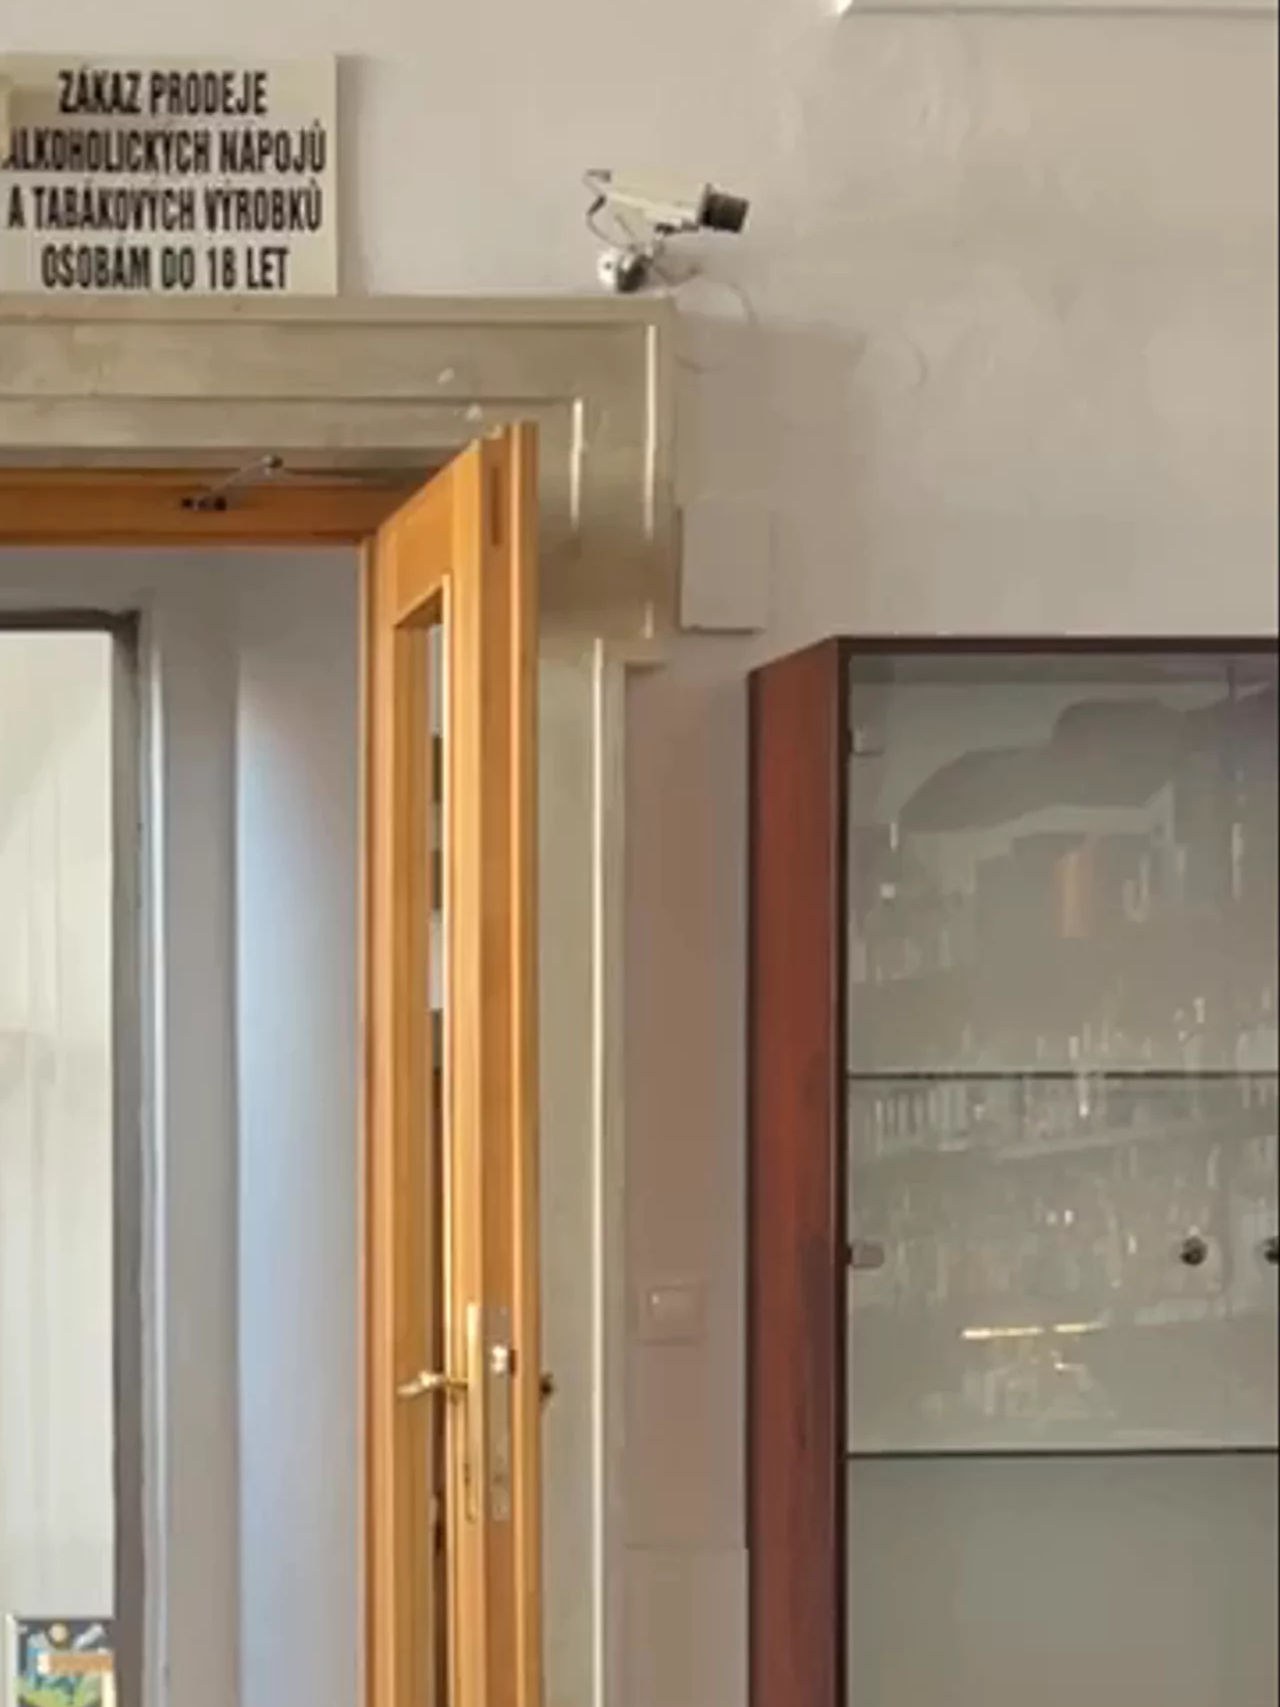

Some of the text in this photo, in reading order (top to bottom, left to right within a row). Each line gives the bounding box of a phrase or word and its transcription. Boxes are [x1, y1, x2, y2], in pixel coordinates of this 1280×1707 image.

[58, 67, 268, 116] ZÁKAZ PRODEJE
[6, 184, 26, 229] A
[203, 179, 323, 232] VÝROBKŮ
[41, 238, 291, 290] OSOBÁM DO 18 LET
